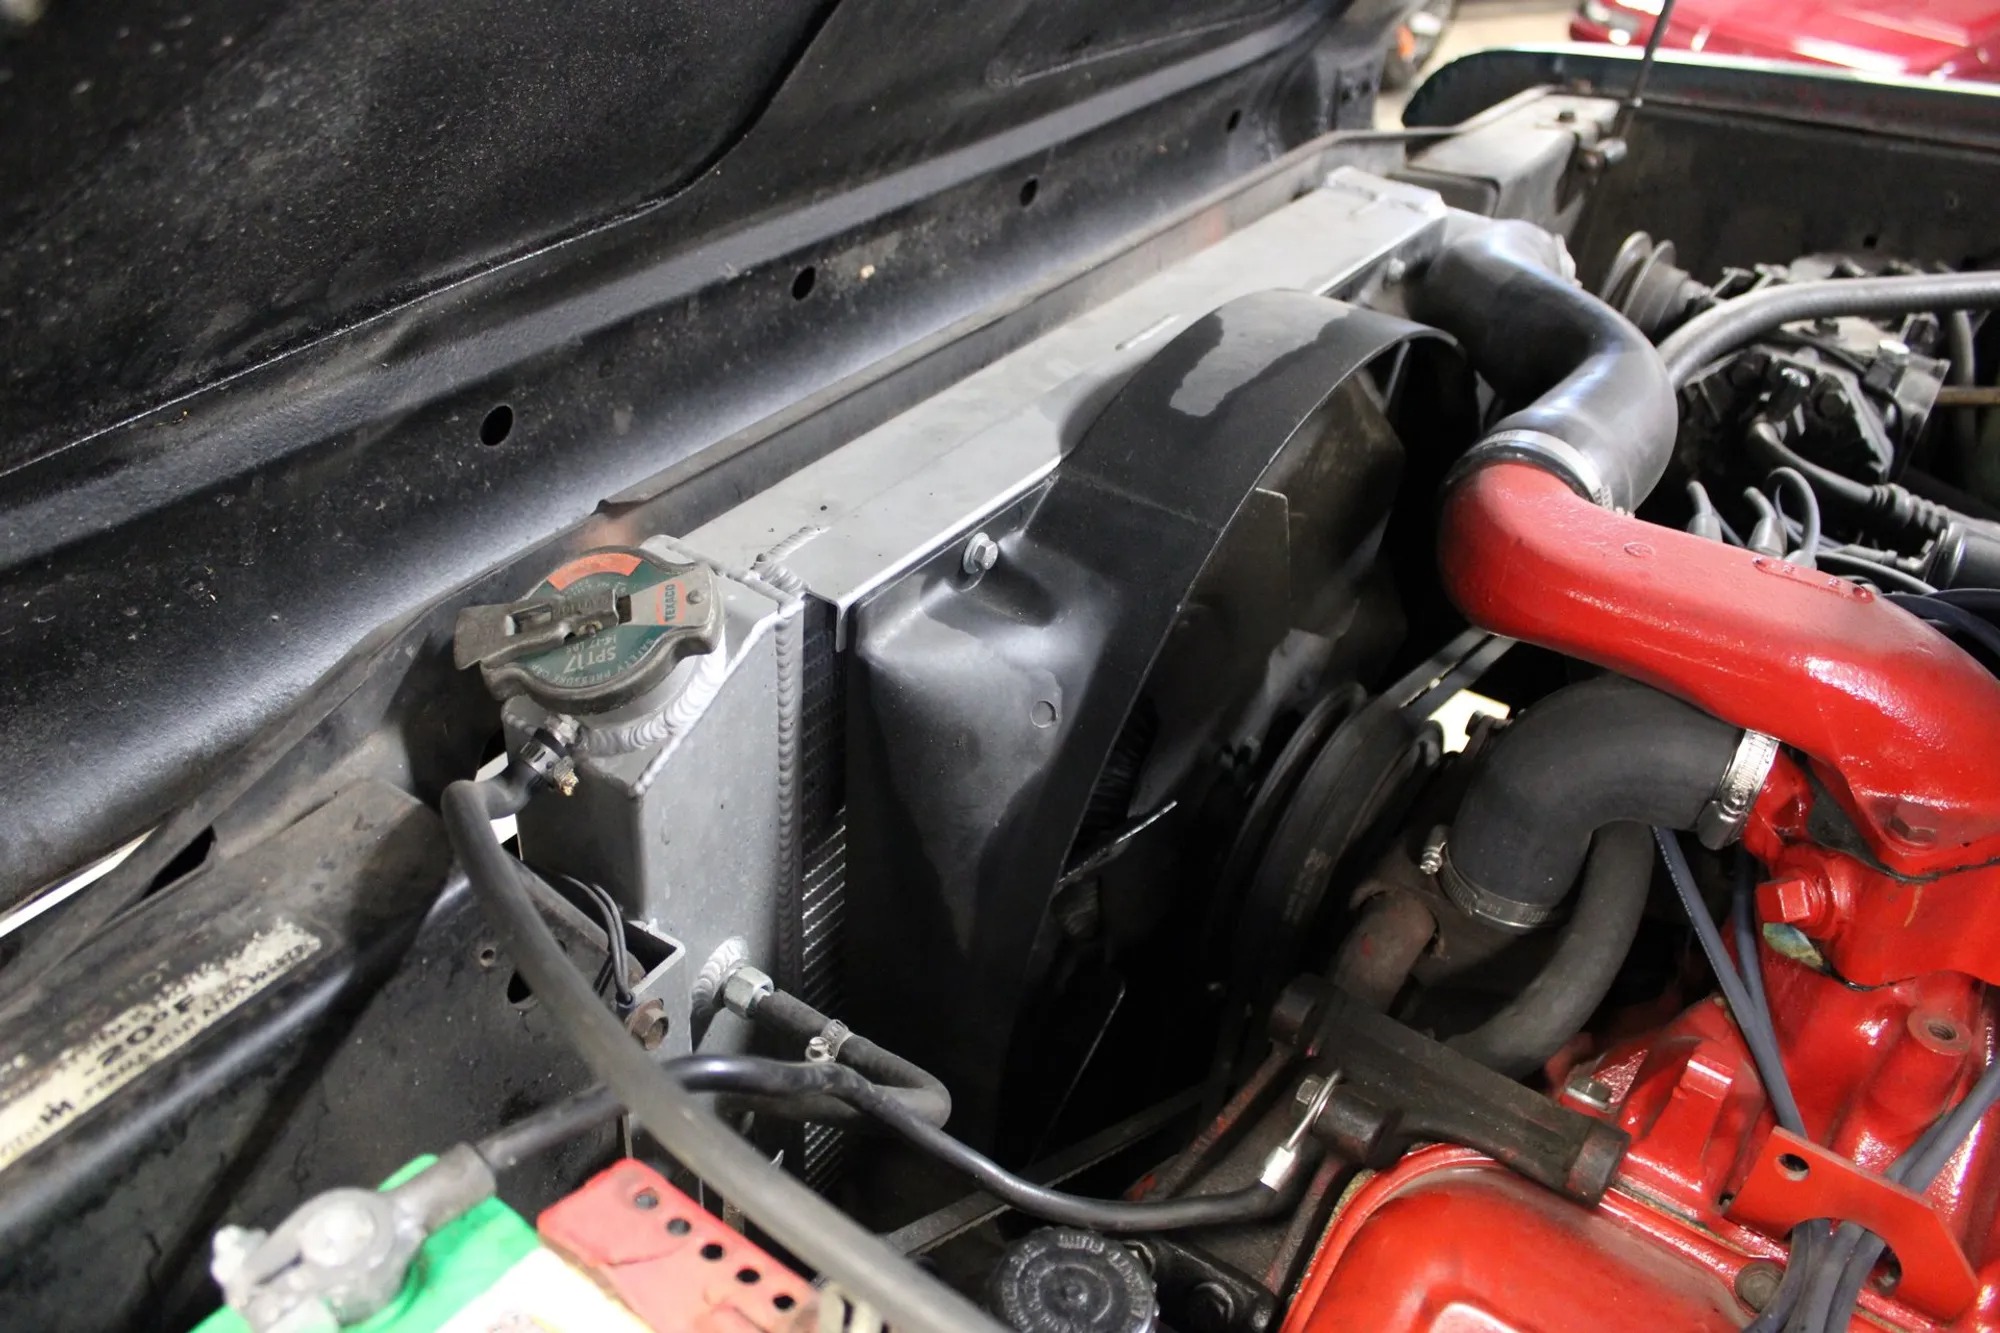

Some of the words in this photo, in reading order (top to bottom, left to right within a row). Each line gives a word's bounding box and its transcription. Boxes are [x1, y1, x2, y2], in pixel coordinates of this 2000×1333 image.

[663, 583, 677, 622] TEXACO
[617, 638, 654, 673] SAFETY
[530, 663, 550, 678] CAP
[554, 670, 611, 686] PRESSURE
